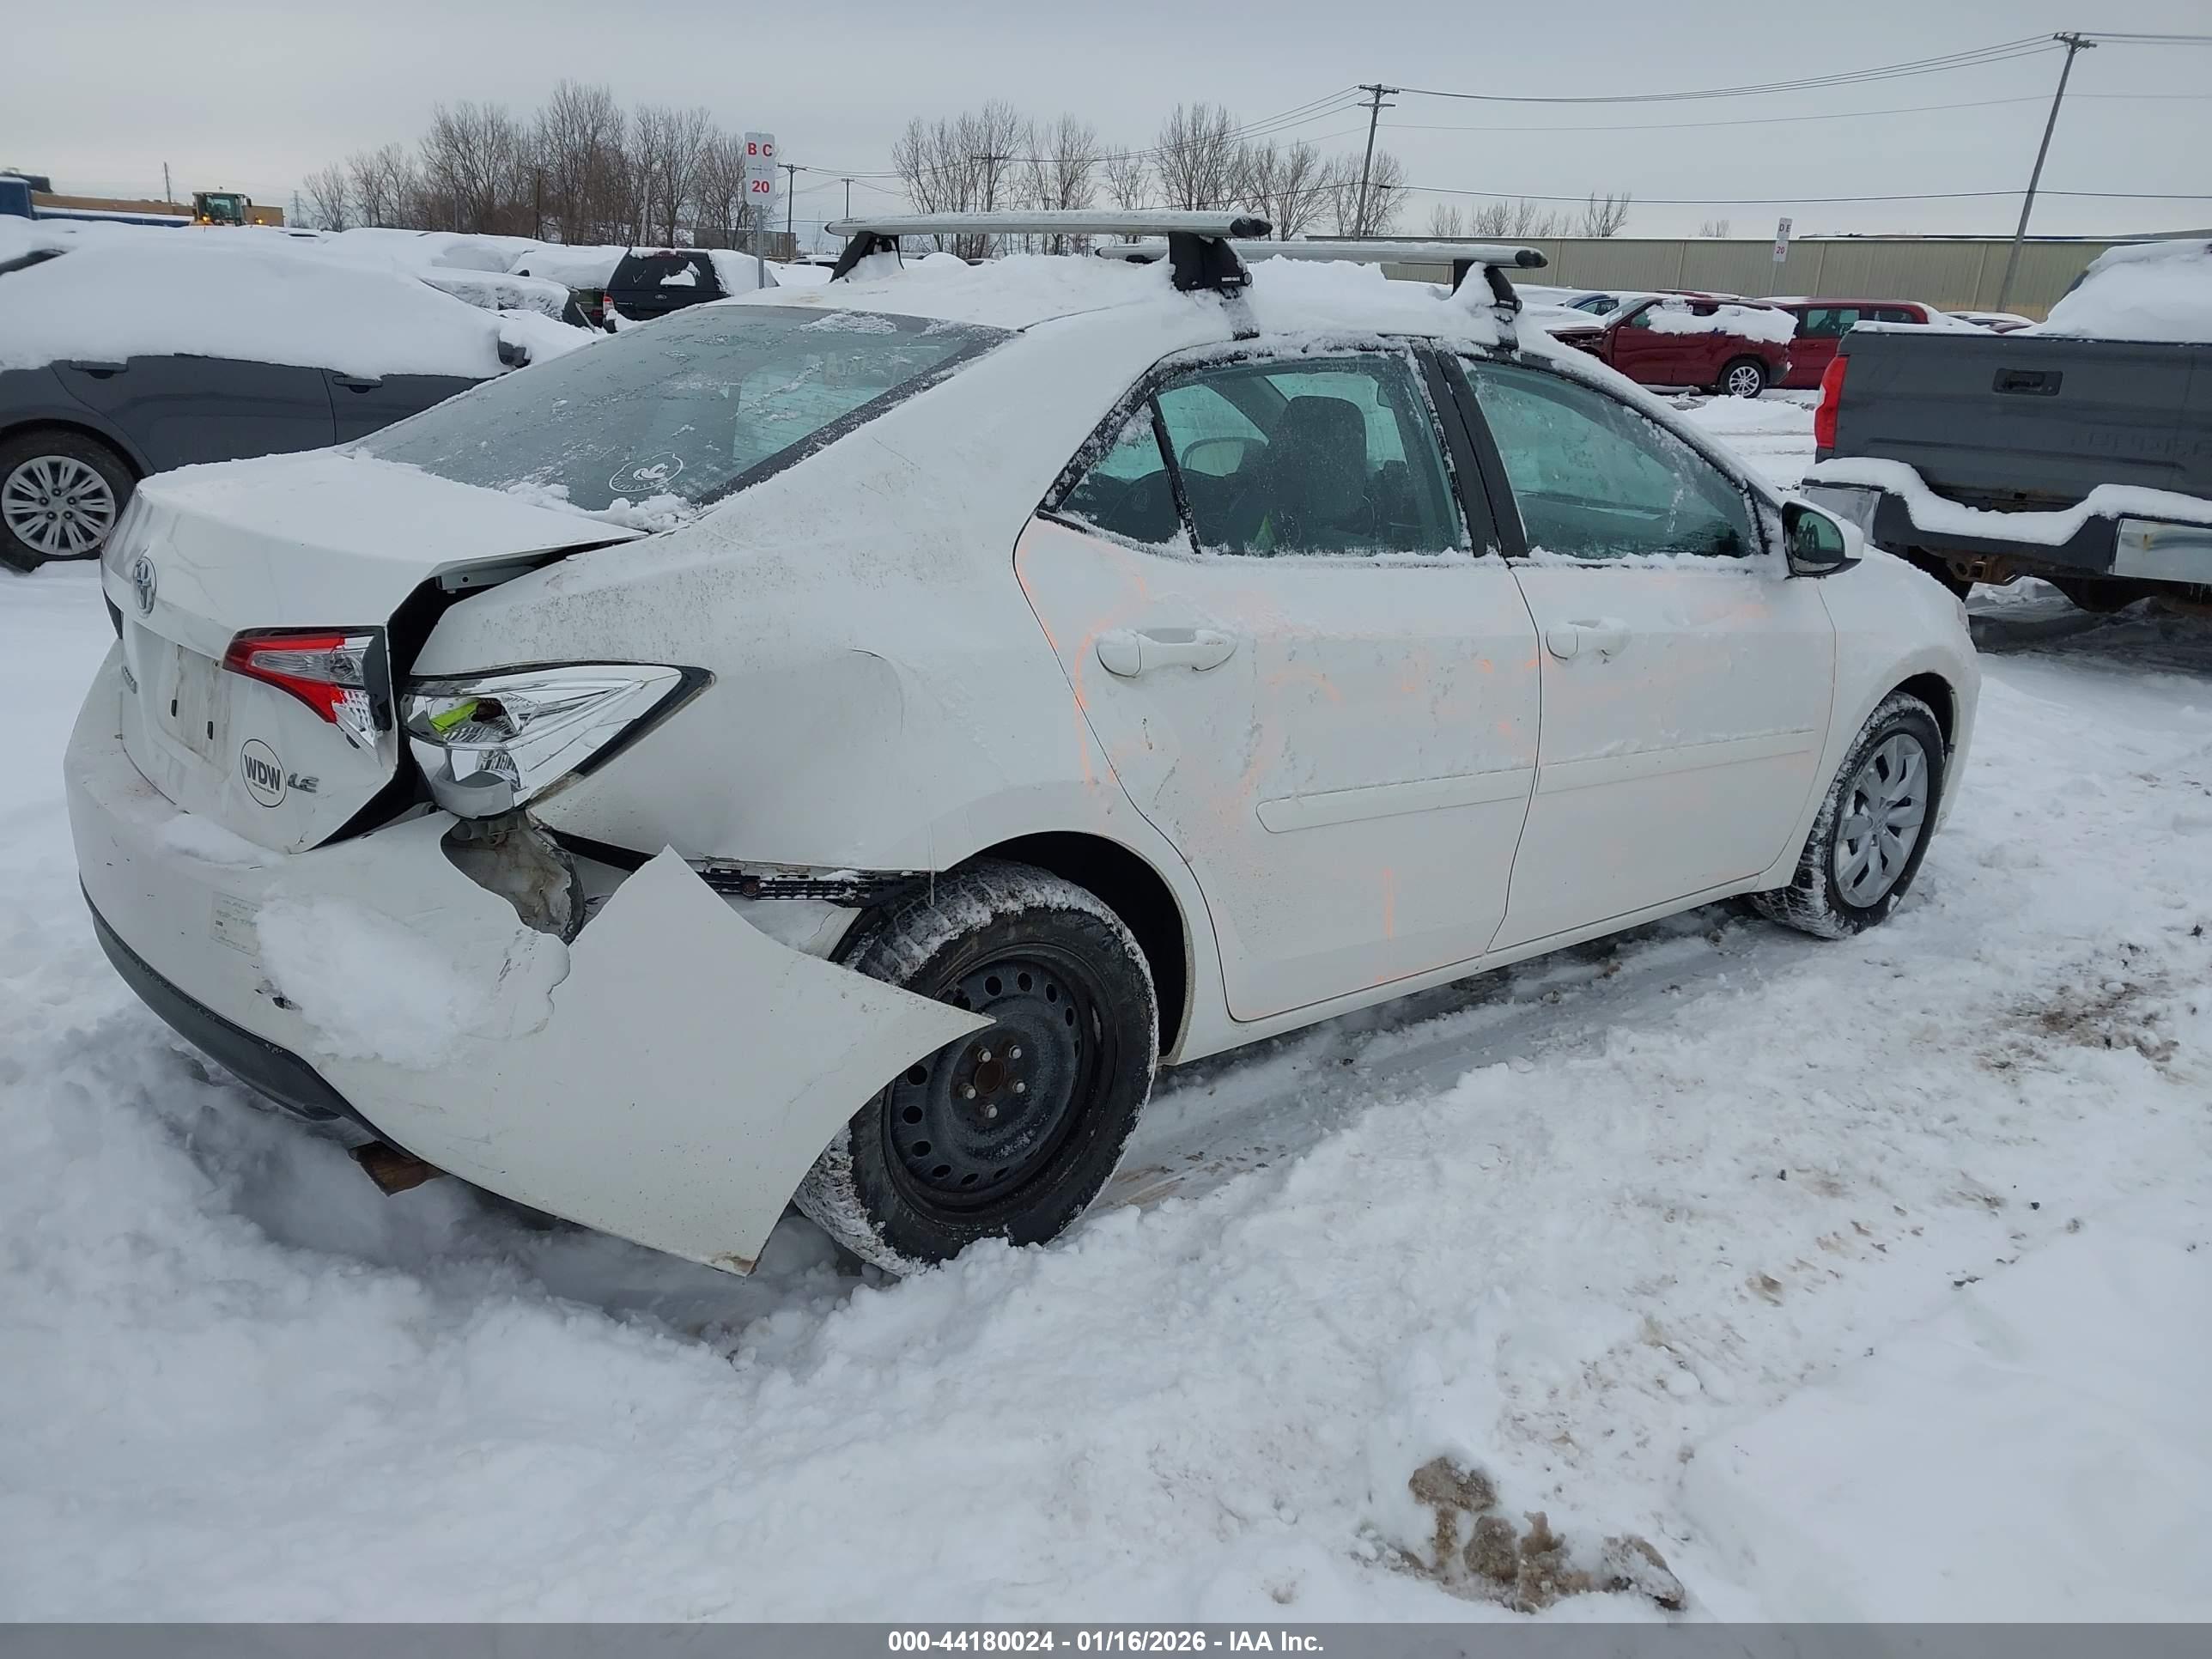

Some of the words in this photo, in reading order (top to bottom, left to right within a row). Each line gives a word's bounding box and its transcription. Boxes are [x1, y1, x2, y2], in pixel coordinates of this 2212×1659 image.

[748, 143, 757, 155] B
[763, 144, 773, 157] C
[751, 180, 770, 193] 20
[1786, 224, 1791, 233] E
[1776, 246, 1785, 254] 20
[244, 754, 281, 792] WDW
[288, 773, 319, 793] LE
